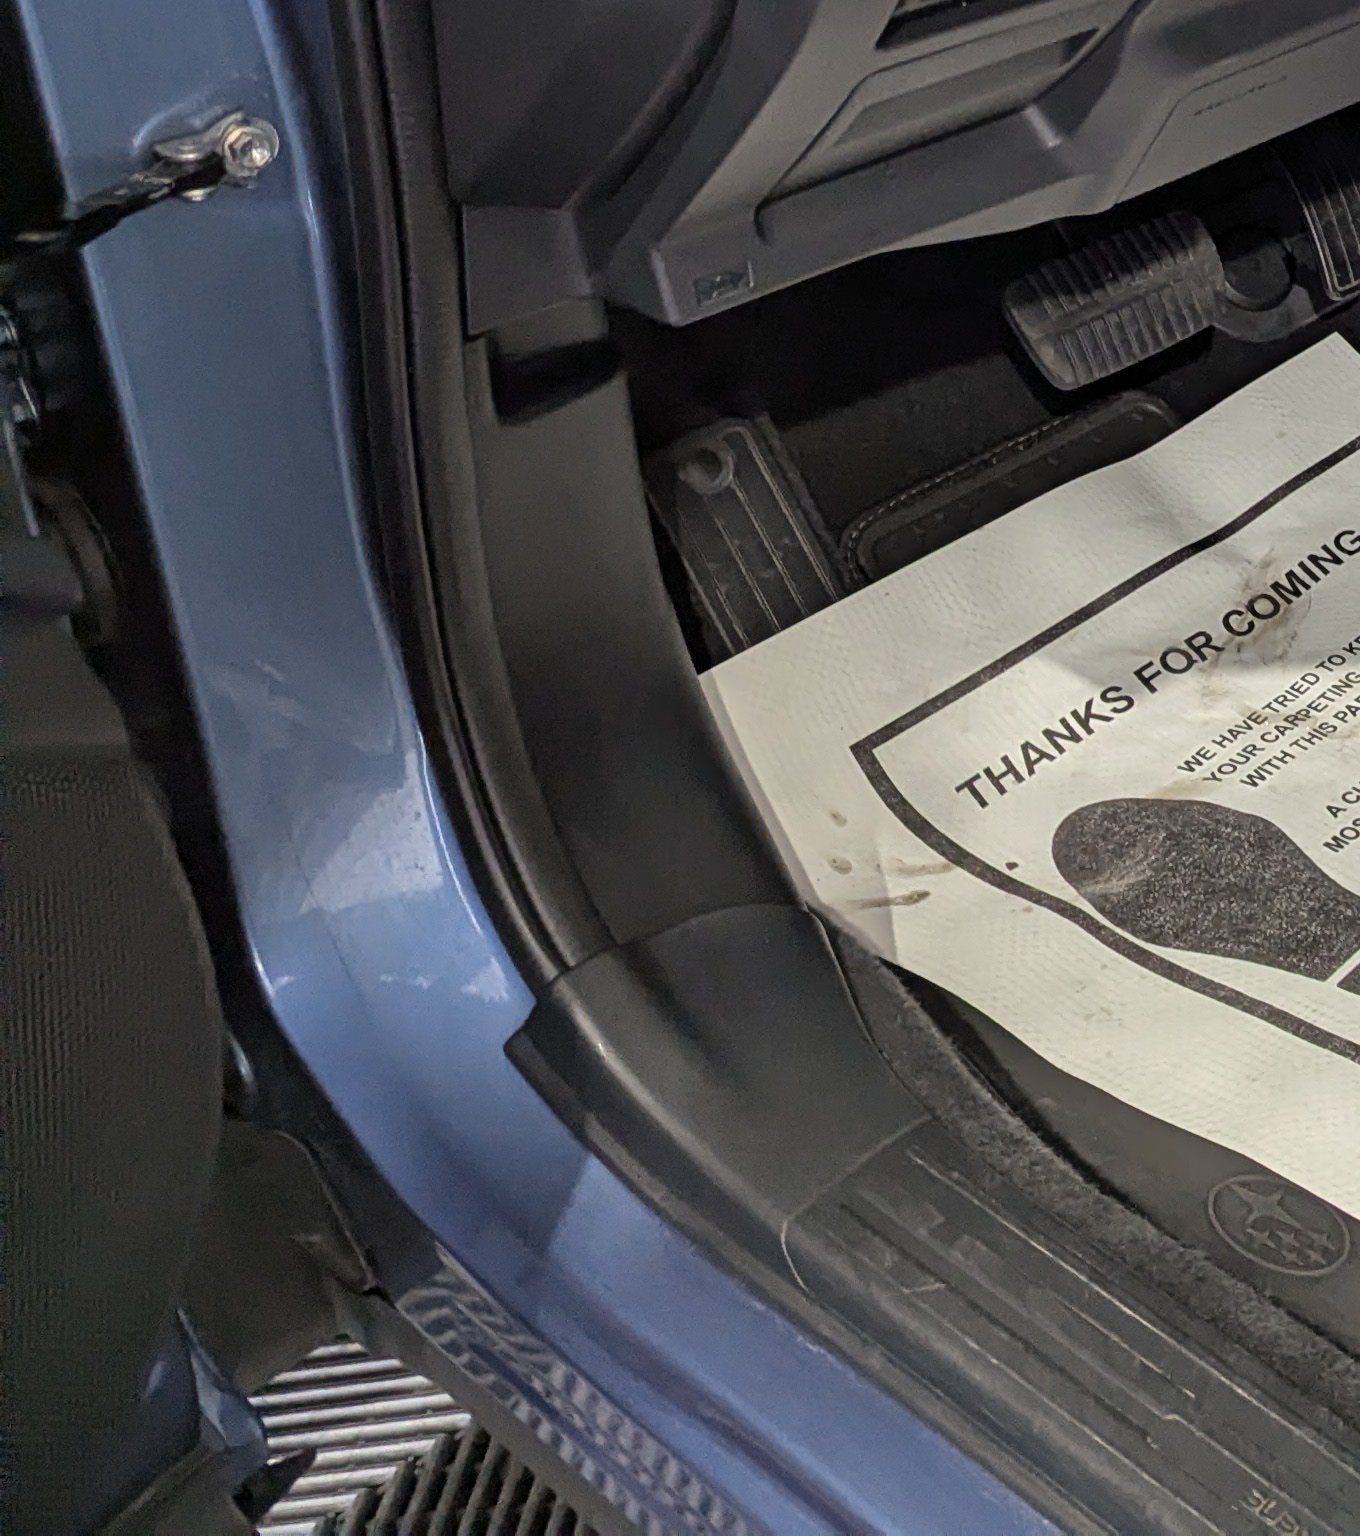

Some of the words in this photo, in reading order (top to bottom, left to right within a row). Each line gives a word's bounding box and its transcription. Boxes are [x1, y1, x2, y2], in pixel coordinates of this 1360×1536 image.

[955, 686, 1135, 810] THANKS
[1134, 630, 1225, 694] FOR
[1178, 746, 1217, 774] WE
[1211, 710, 1268, 750] HAVE
[1262, 672, 1320, 714] TRIED
[1315, 654, 1347, 674] TO
[1203, 743, 1265, 784] YOUR
[1239, 749, 1296, 789] WITH
[1289, 721, 1338, 752] THIS
[1326, 804, 1347, 818] A
